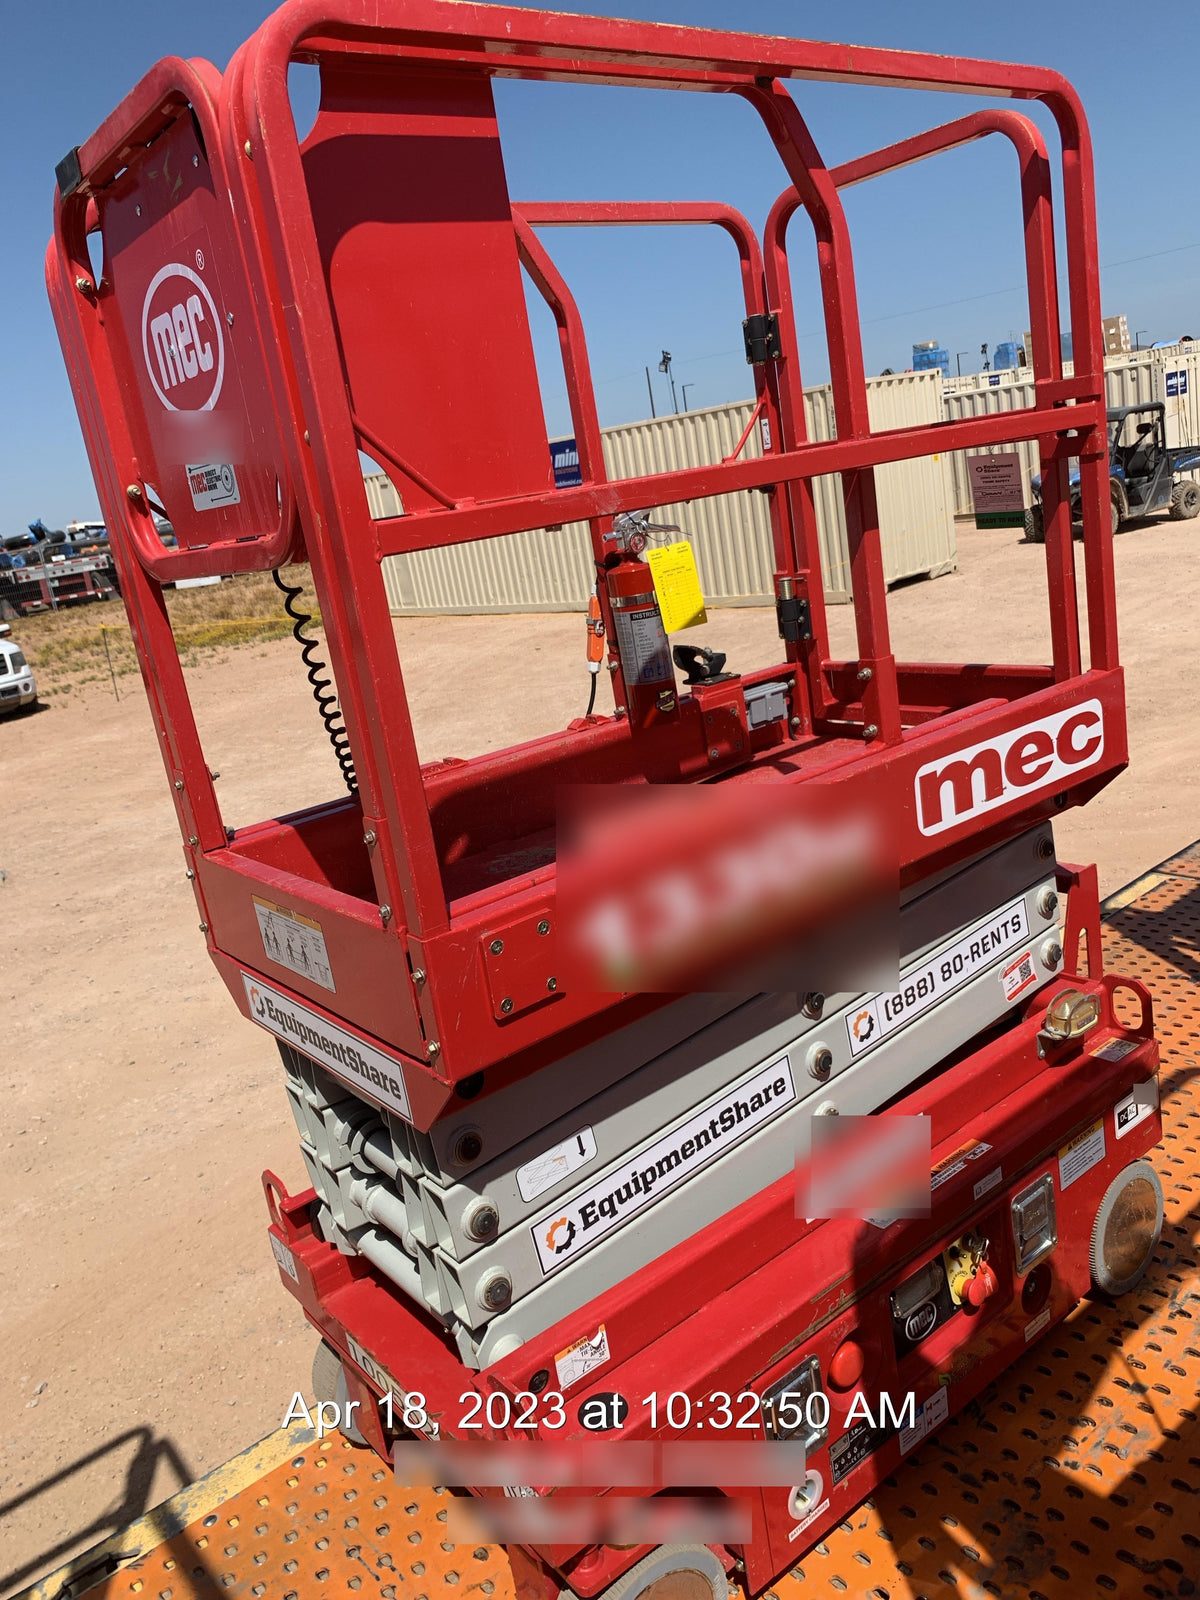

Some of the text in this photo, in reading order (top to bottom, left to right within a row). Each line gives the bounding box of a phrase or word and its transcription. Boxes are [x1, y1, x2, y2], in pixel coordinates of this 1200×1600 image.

[151, 294, 214, 390] mec
[918, 711, 1102, 829] mec
[884, 971, 935, 1021] (888)
[940, 914, 1021, 982] 80-RENTS
[264, 996, 402, 1101] EquipmentShare
[578, 1077, 787, 1232] EquipmentShare
